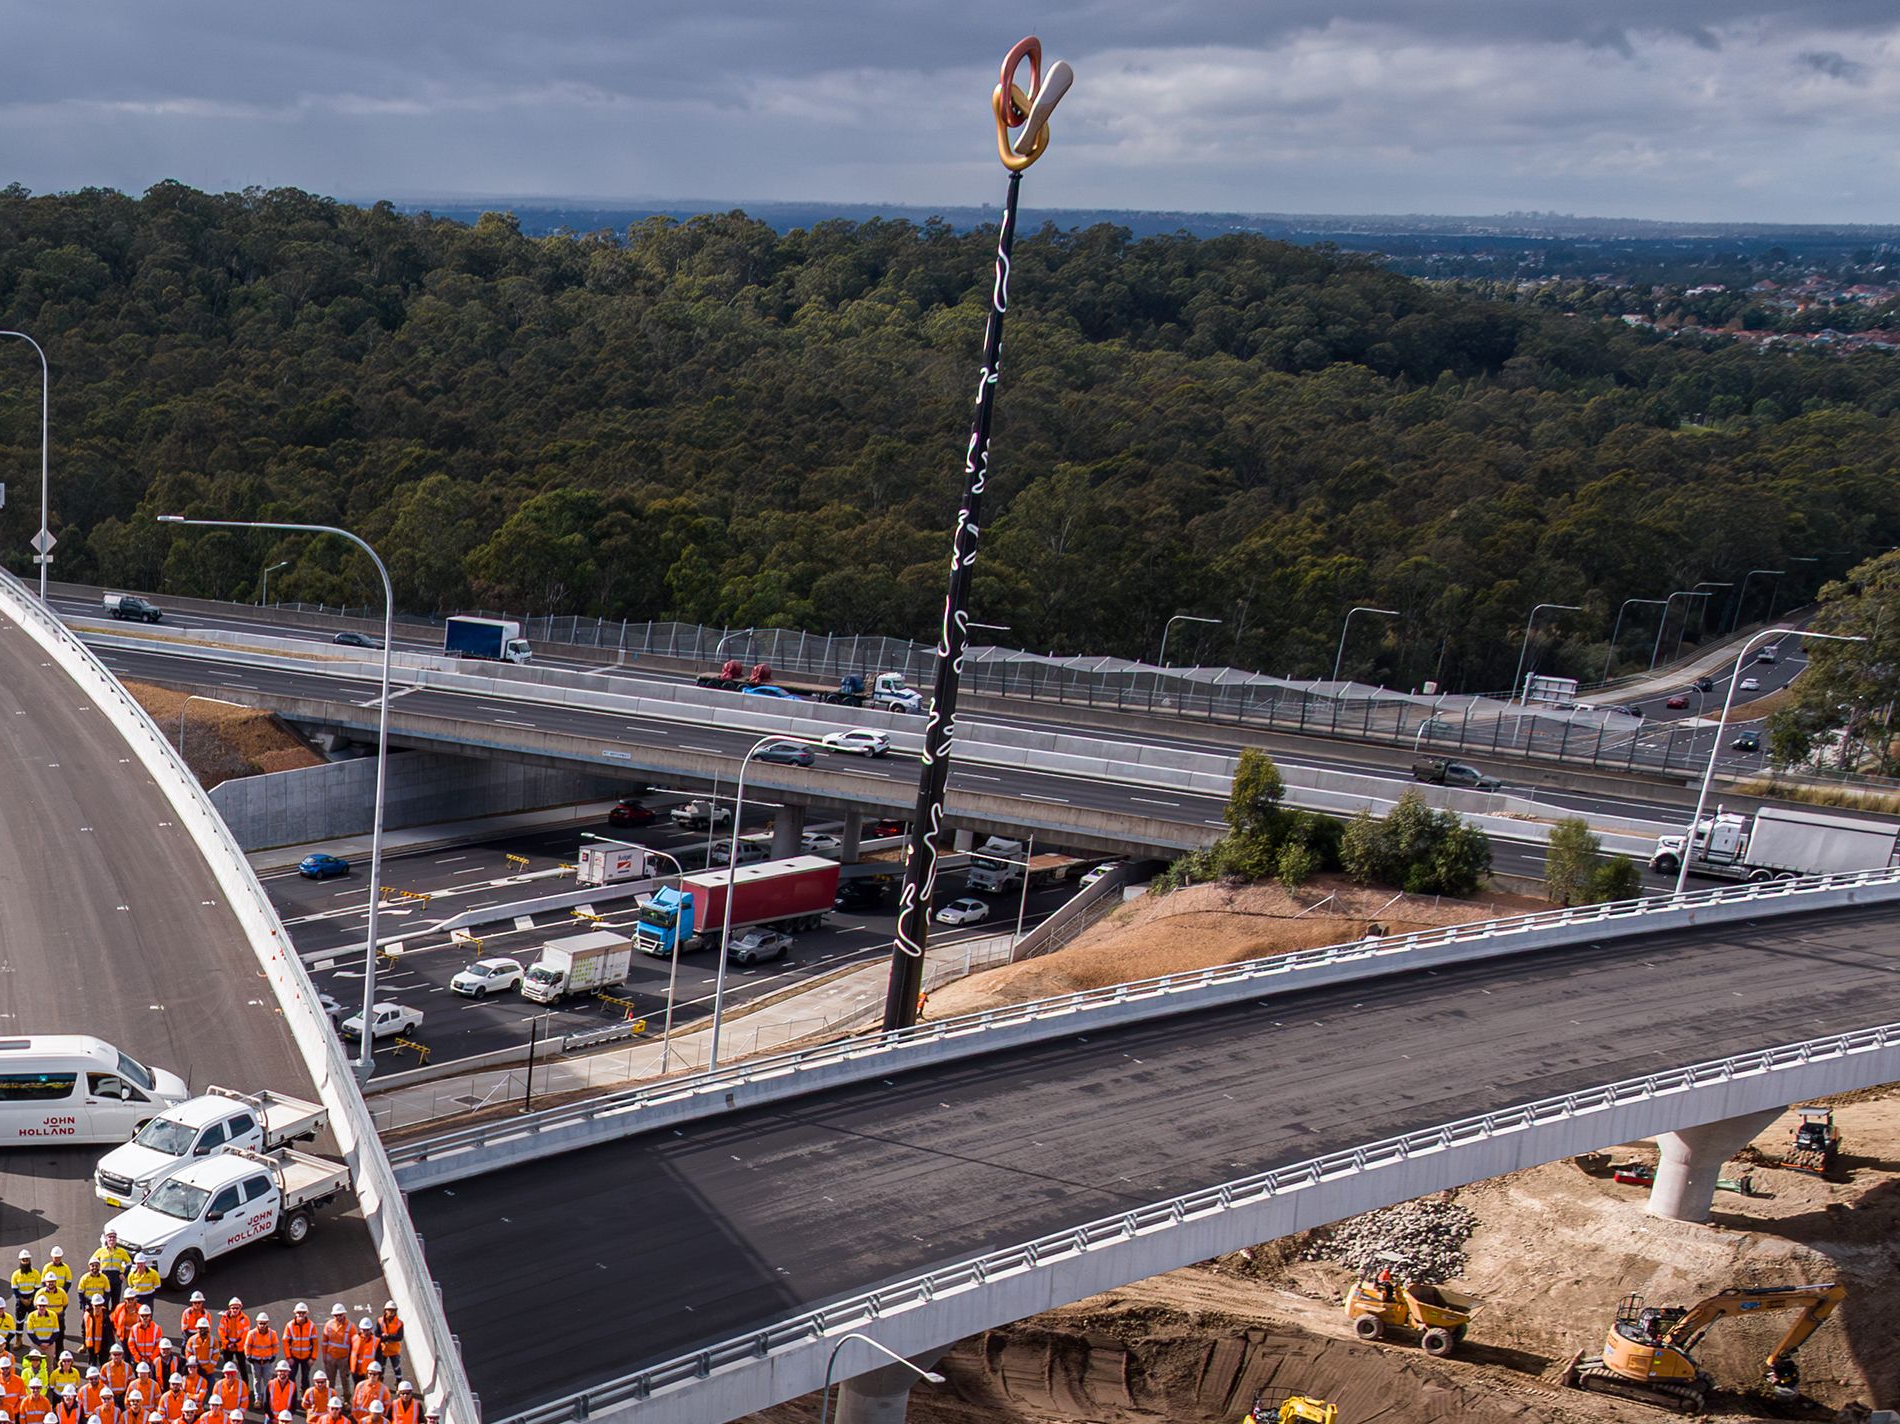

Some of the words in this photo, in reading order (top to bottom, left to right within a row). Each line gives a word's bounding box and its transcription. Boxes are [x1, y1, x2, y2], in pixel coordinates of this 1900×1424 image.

[43, 1117, 75, 1125] JOHN
[19, 1128, 75, 1136] HOLLAND
[247, 1209, 272, 1225] JOHN
[227, 1221, 272, 1245] HOLLAND
